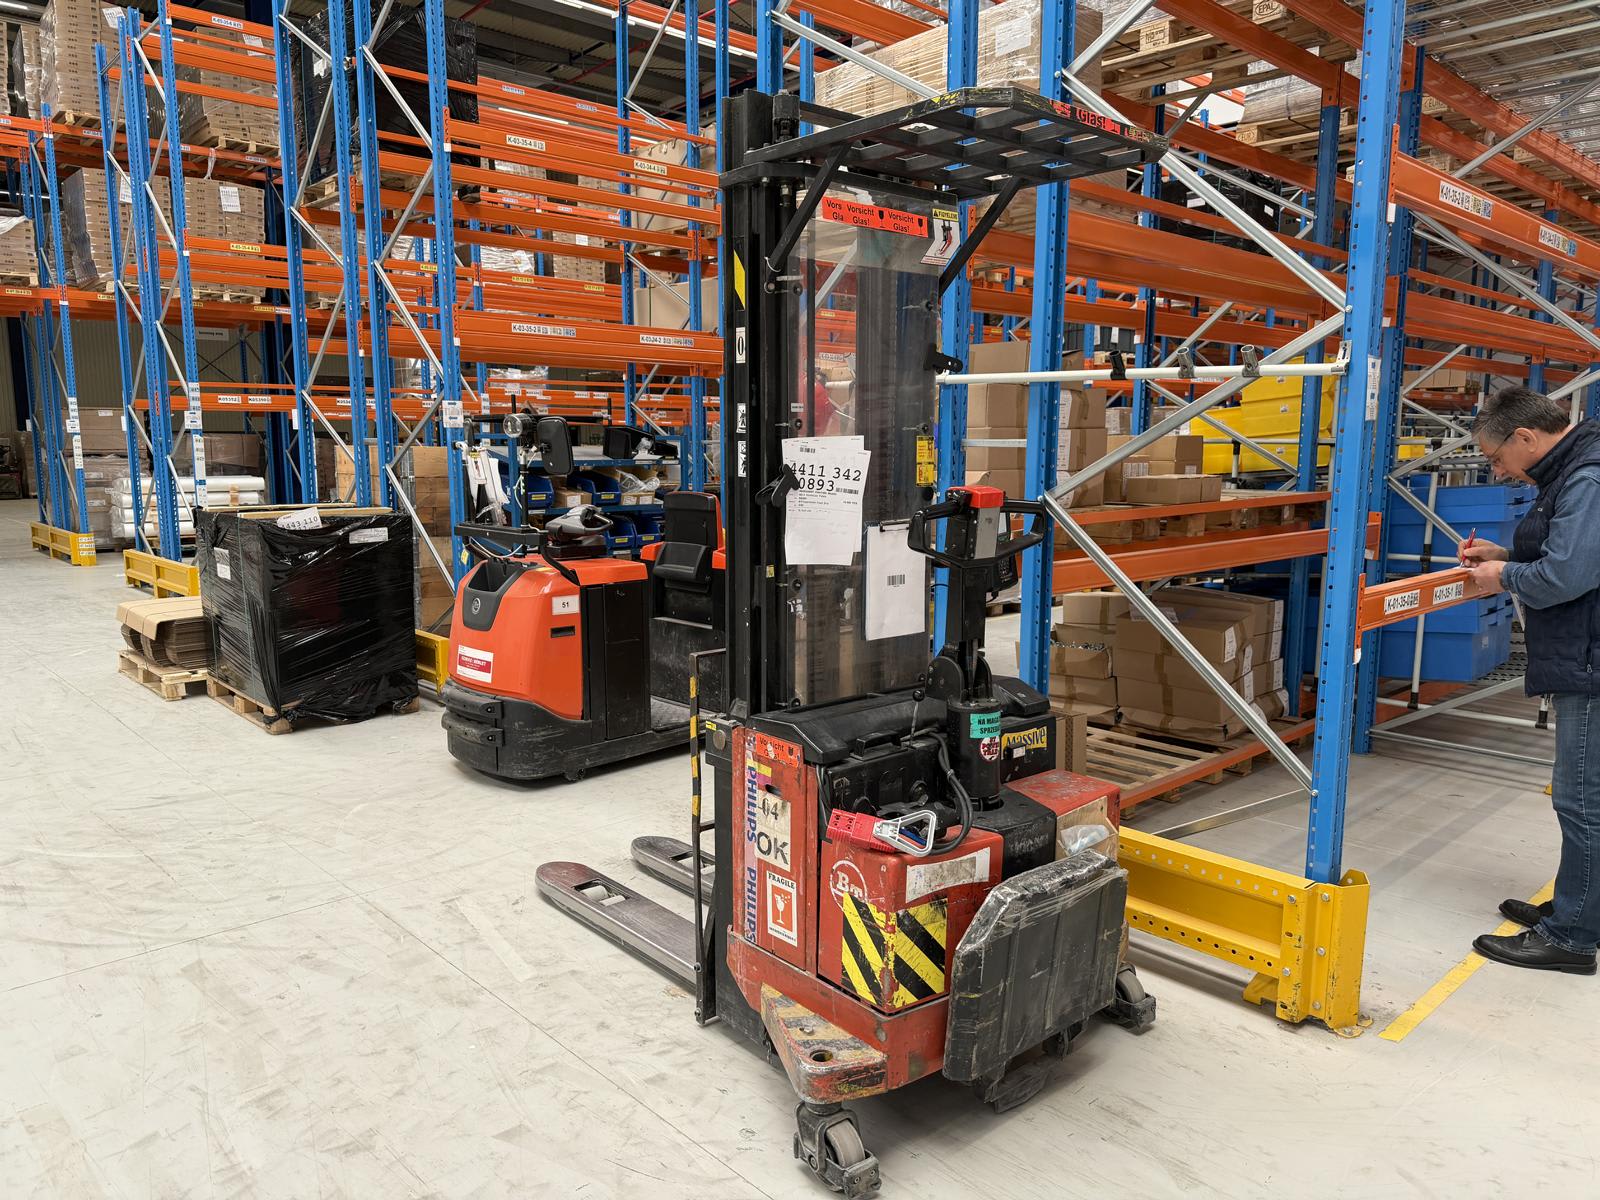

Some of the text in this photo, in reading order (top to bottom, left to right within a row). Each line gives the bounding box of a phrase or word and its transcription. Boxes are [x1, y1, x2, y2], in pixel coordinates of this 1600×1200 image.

[826, 199, 914, 224] Vors Vorsicht Vorsicht
[832, 212, 910, 233] Gla Glas! Glas!
[789, 462, 862, 482] 4411 342
[304, 515, 318, 526] 110
[561, 601, 570, 609] 51
[747, 766, 758, 843] PHILIPS
[757, 831, 789, 866] OK
[768, 871, 796, 890] FRAGILE
[746, 866, 757, 944] PHILIPS
